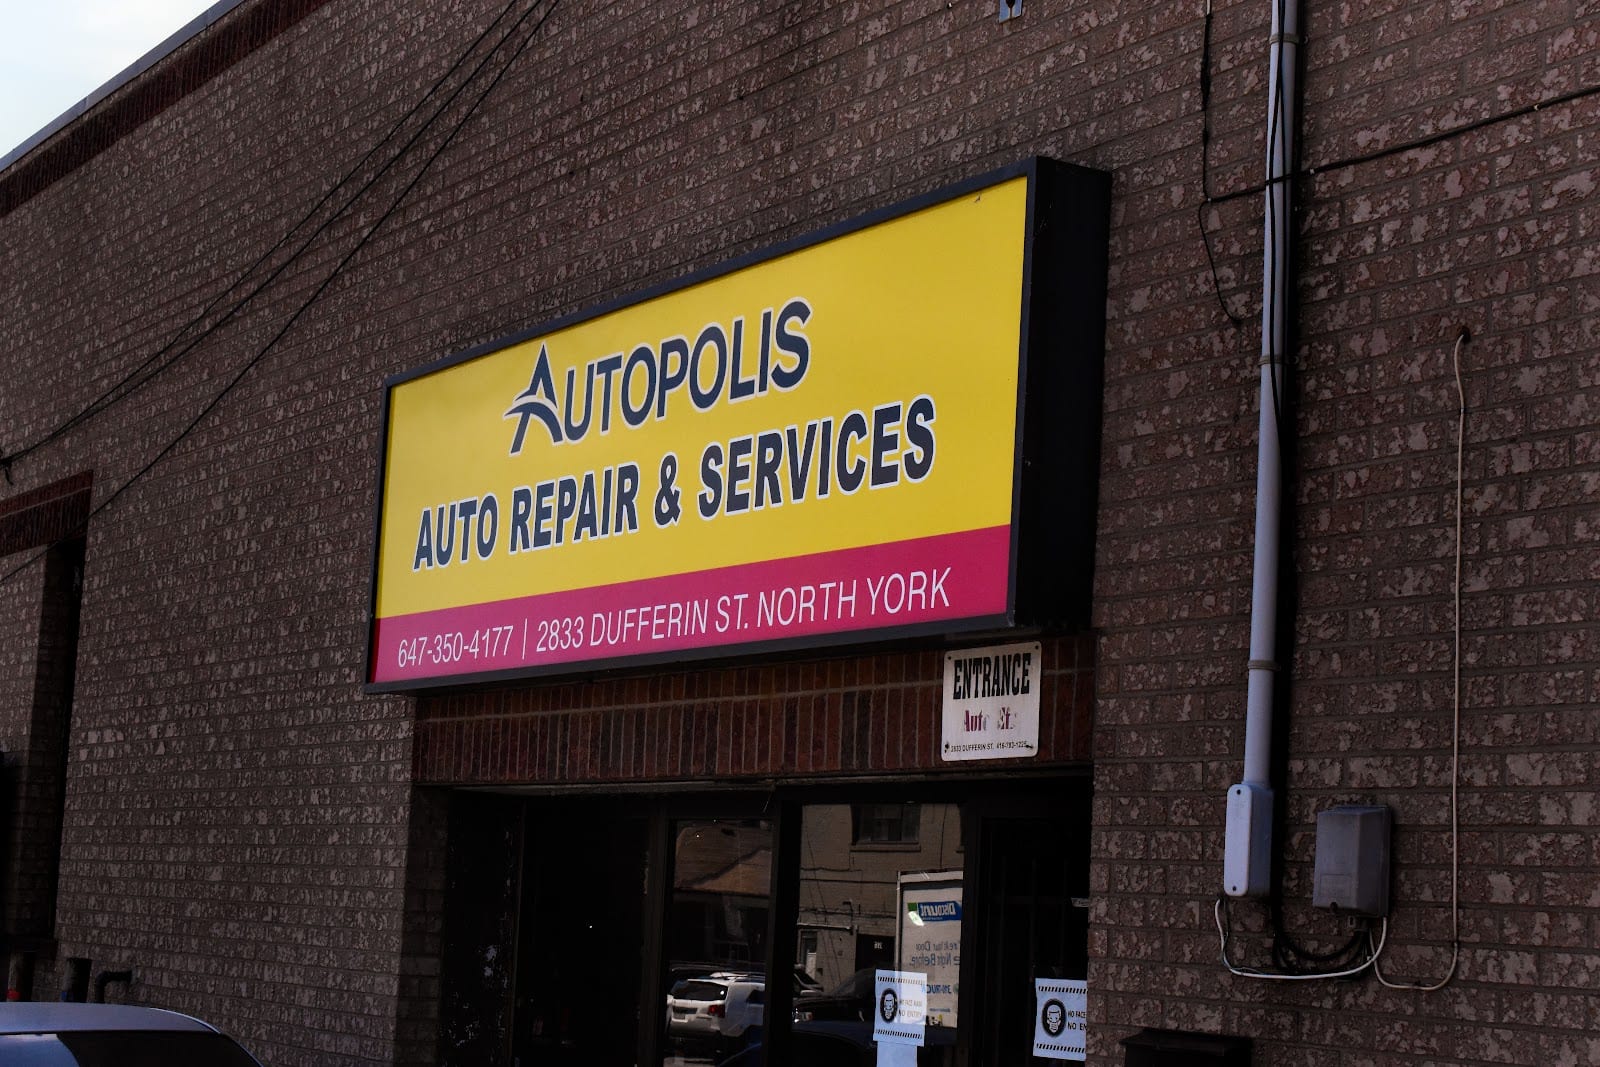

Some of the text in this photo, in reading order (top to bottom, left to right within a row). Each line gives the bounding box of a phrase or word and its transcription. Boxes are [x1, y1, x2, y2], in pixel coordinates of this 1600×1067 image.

[503, 297, 813, 455] AUTOPOLIS
[413, 394, 936, 572] AUTO REPAIR & SERVICES
[397, 625, 514, 668] 647-350-4177
[536, 616, 585, 653] 2833
[589, 598, 709, 647] DUFFERIN
[715, 593, 750, 633] ST.
[757, 579, 857, 628] NORTH
[866, 567, 952, 616] YORK
[953, 653, 1032, 700] ENTRANCE
